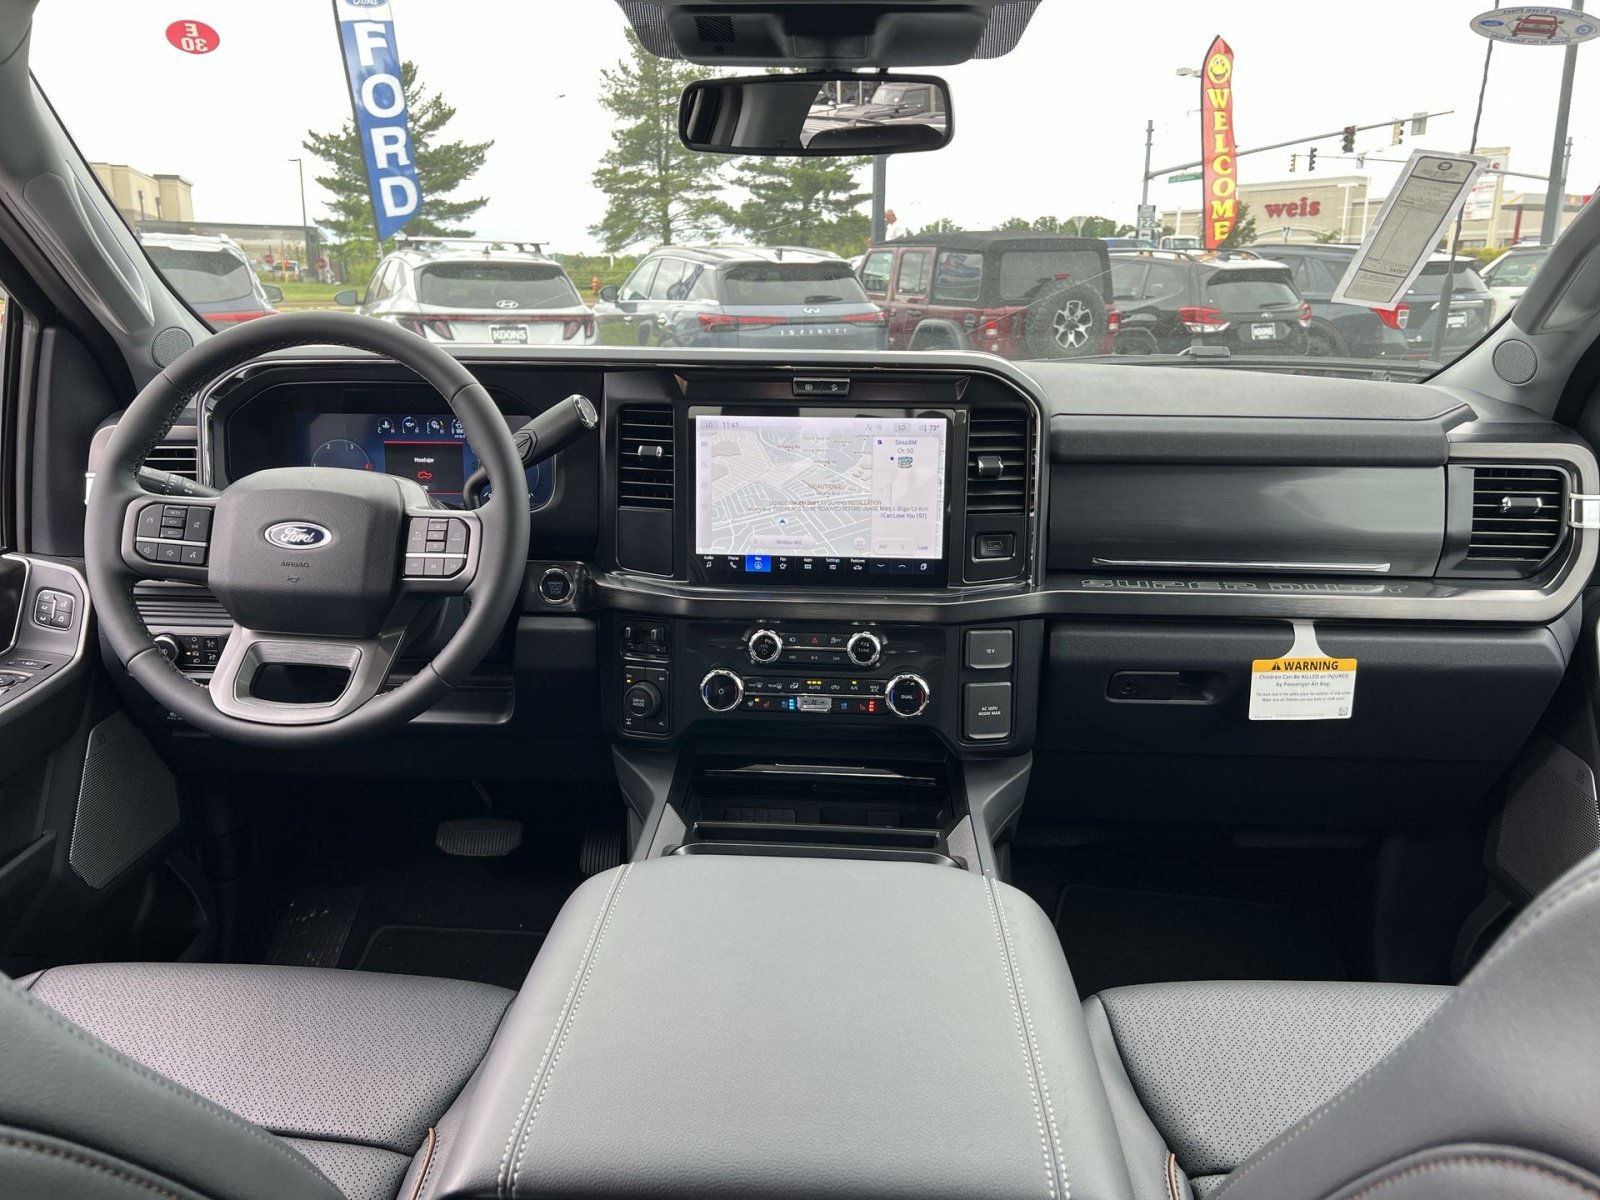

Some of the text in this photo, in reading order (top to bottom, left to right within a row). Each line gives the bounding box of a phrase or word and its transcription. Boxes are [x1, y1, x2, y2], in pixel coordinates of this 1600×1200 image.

[353, 22, 418, 218] FORD
[1207, 88, 1236, 241] WELCOME
[1264, 197, 1321, 218] weis
[493, 330, 527, 340] KOONS
[280, 527, 316, 543] Ford
[1080, 579, 1409, 594] SUPER DUTY
[1284, 661, 1339, 670] WARNING
